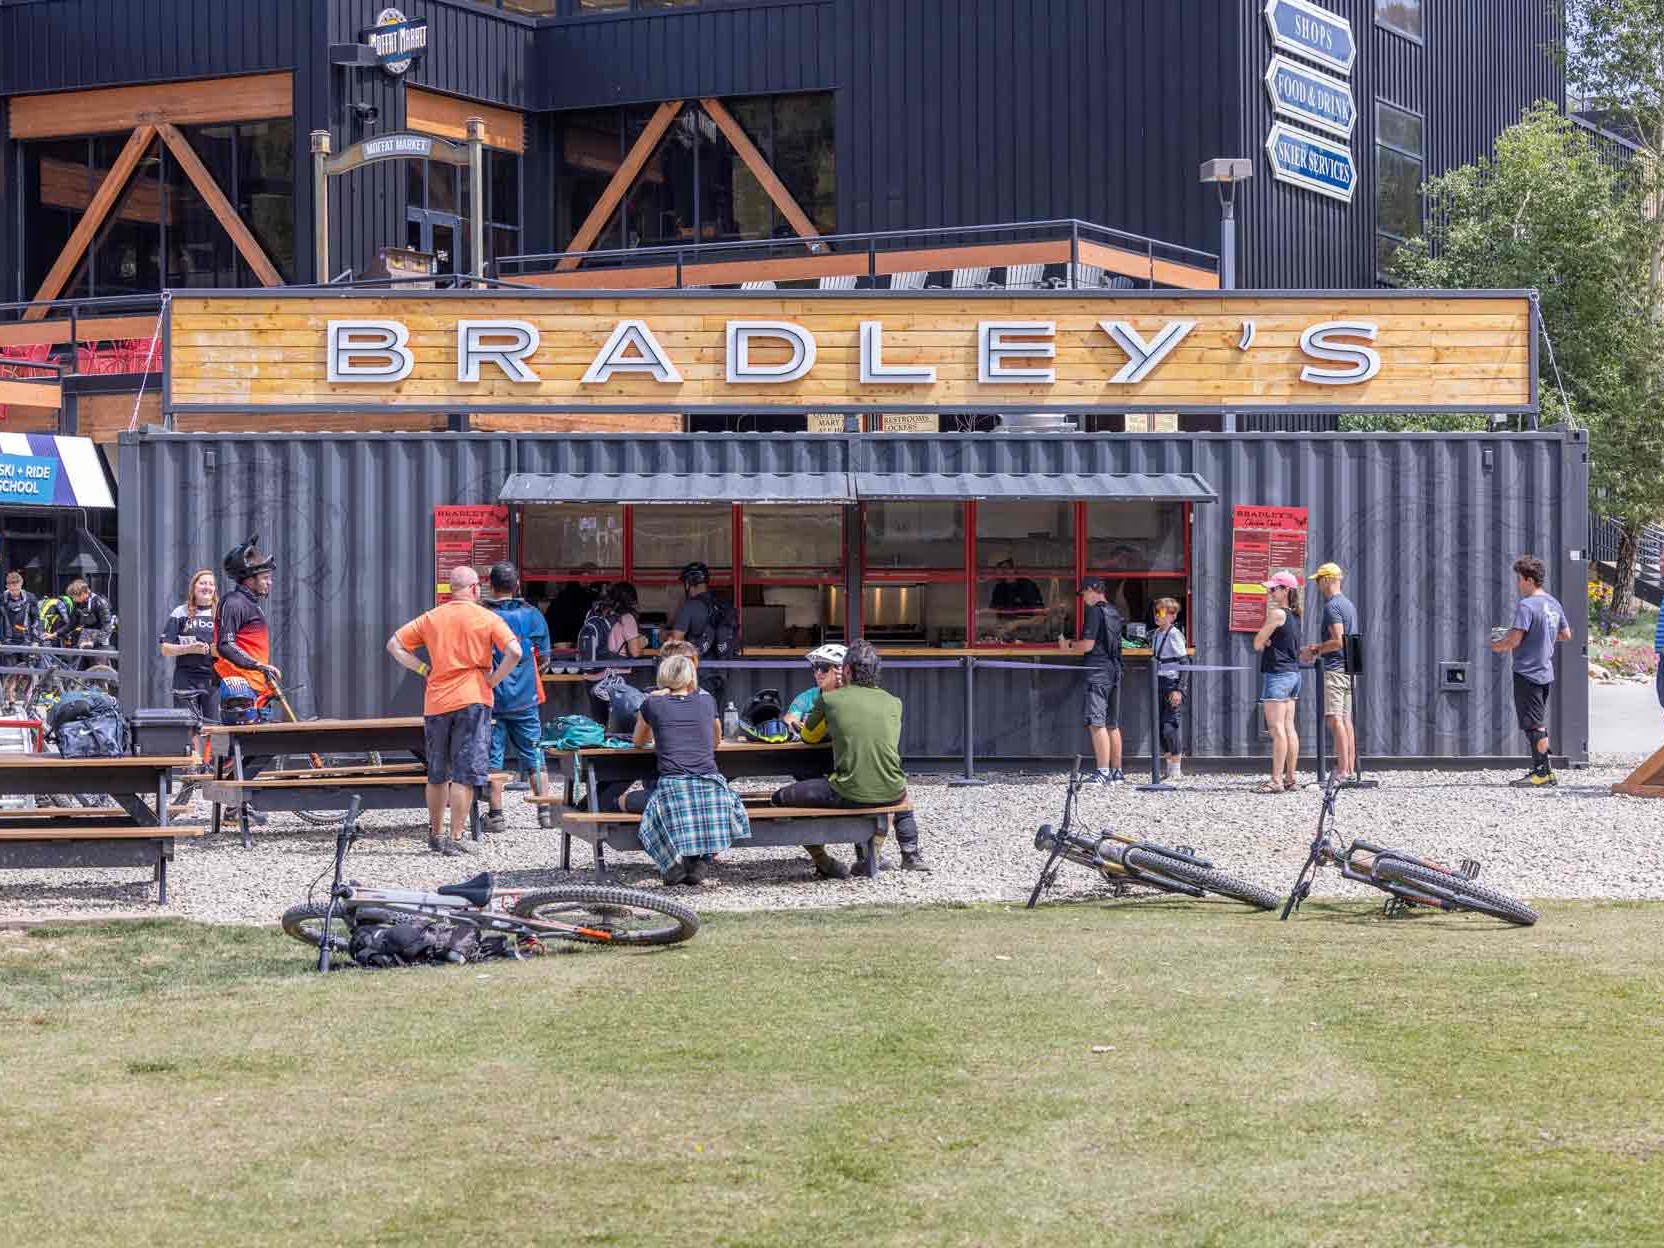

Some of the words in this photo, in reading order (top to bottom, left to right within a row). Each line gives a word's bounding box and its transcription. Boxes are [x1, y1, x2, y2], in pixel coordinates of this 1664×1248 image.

[397, 26, 427, 55] MARKET
[1294, 14, 1332, 50] SHOPS
[1278, 73, 1306, 103] FOOD
[1307, 87, 1316, 107] &
[1317, 89, 1350, 121] DRINK
[366, 139, 393, 155] MOFFAT
[395, 138, 427, 151] MARKET
[1278, 142, 1307, 170] SKIER
[1308, 149, 1350, 184] SERVICES
[326, 319, 1381, 385] BRADLEY'S
[26, 465, 51, 479] RIDE
